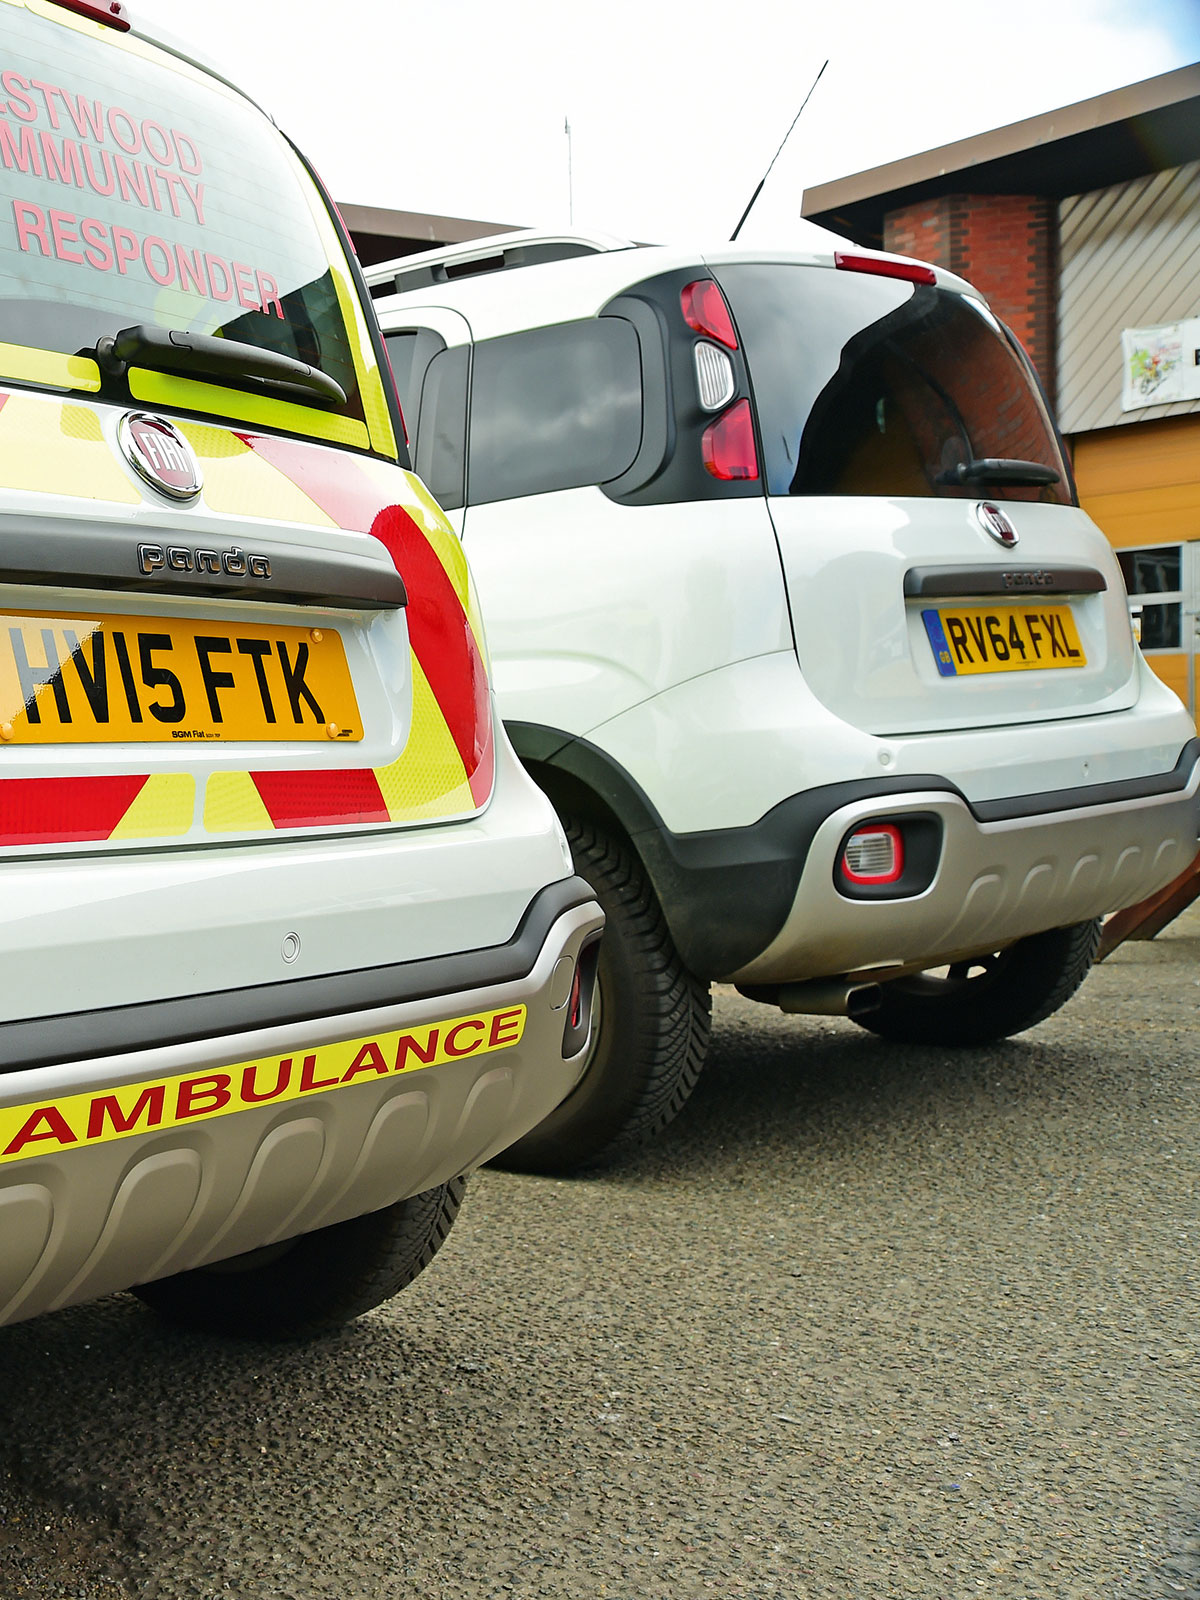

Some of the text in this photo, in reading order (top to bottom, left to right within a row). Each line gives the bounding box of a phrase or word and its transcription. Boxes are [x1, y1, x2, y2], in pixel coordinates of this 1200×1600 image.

[12, 199, 285, 320] RESPONDER
[139, 432, 190, 473] FIAT
[137, 542, 272, 581] panda
[945, 614, 1081, 664] RV64 FXL
[8, 627, 326, 724] HV15 FTK
[171, 730, 192, 739] SGM
[1, 1009, 523, 1156] AMBULANCE
